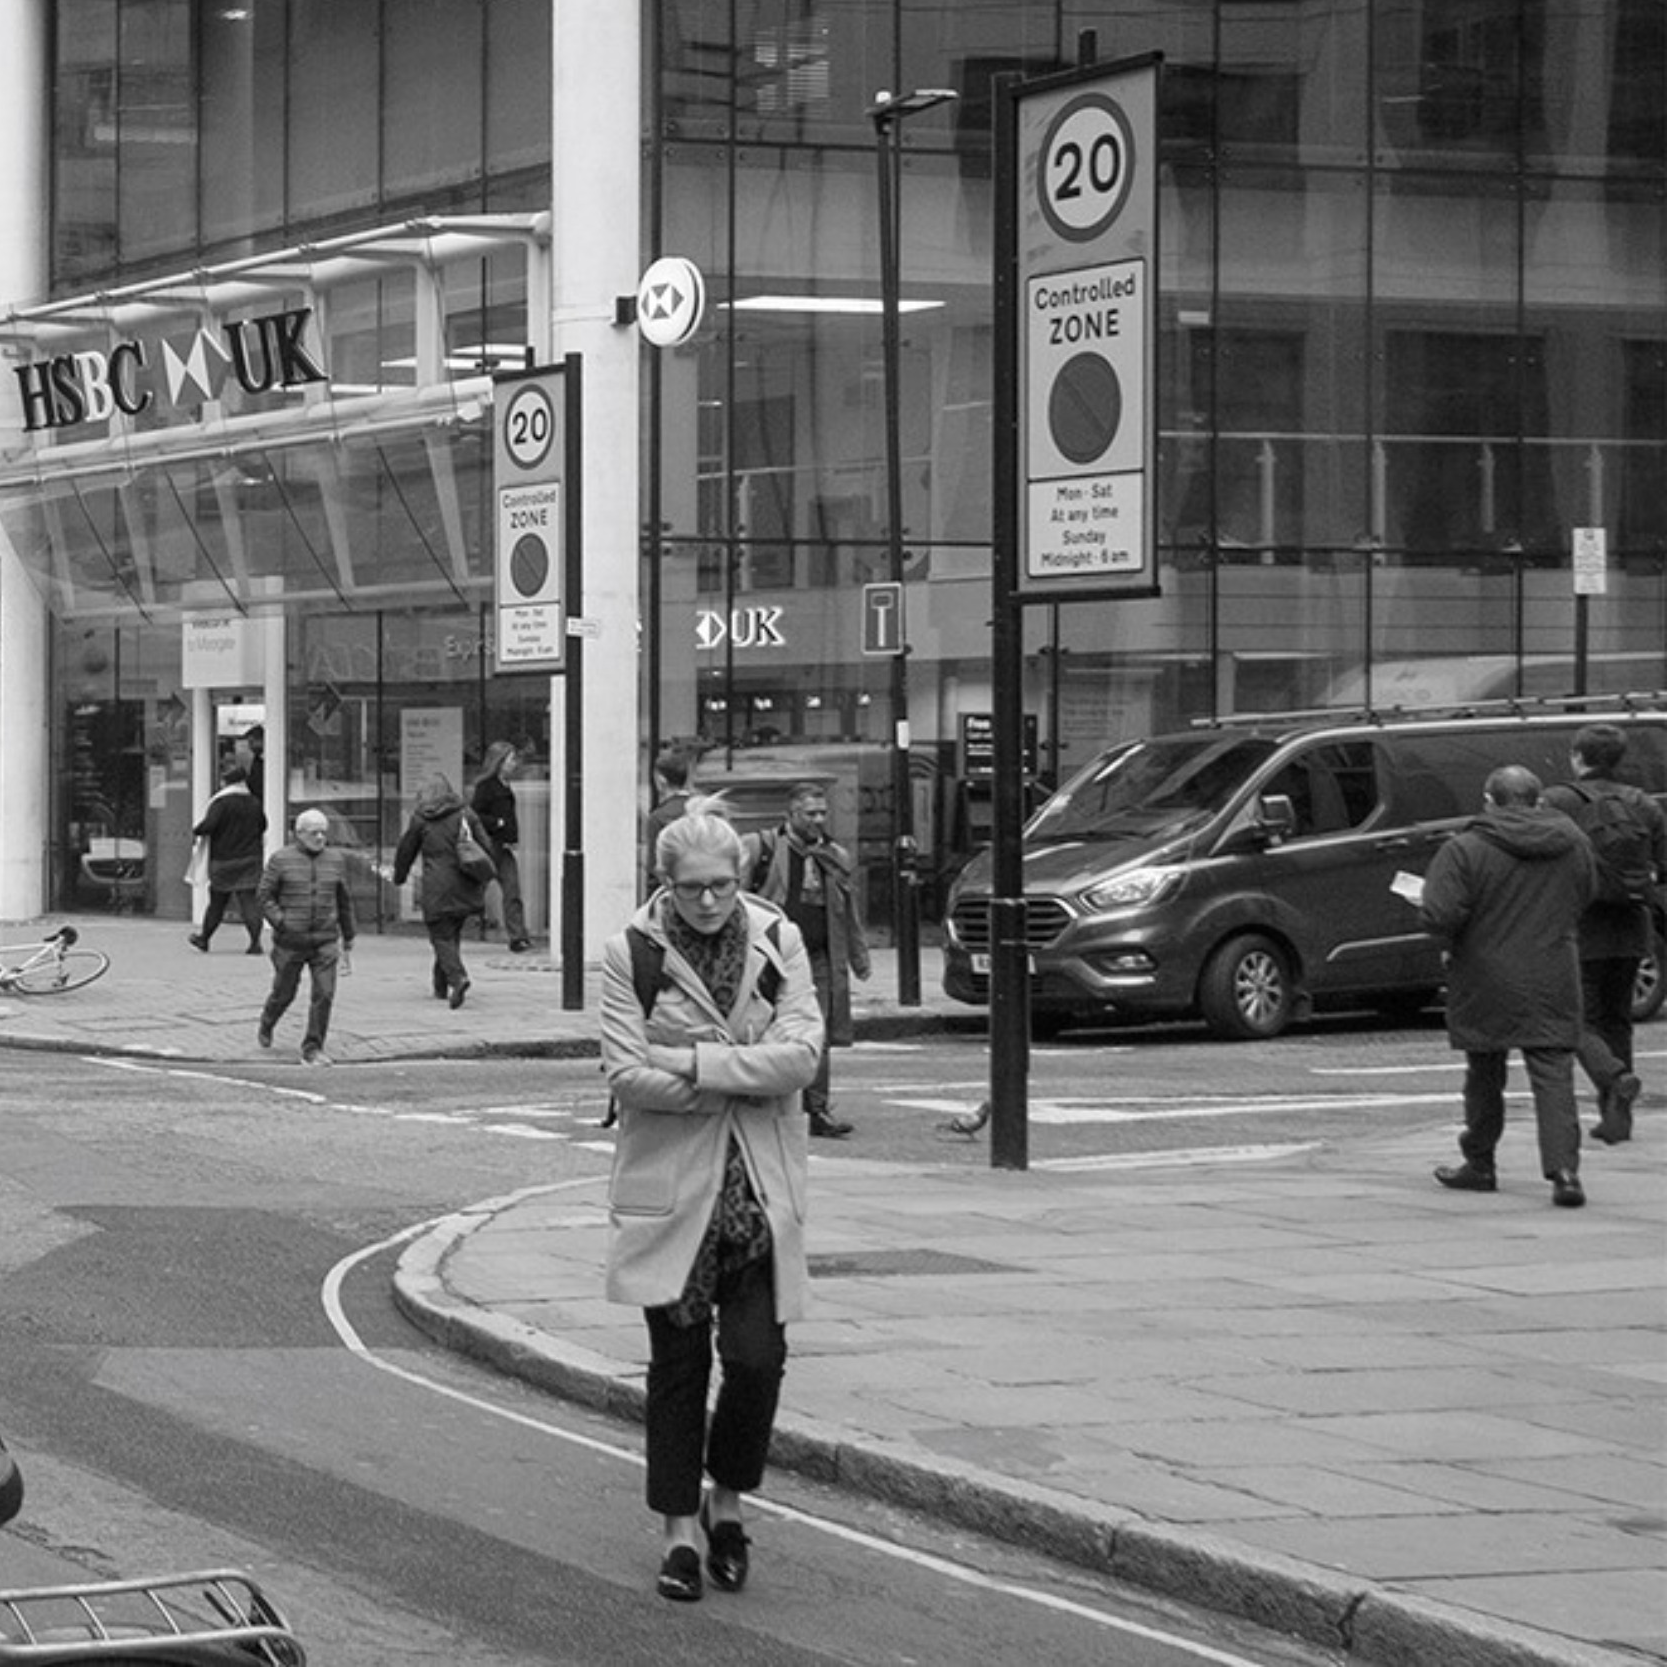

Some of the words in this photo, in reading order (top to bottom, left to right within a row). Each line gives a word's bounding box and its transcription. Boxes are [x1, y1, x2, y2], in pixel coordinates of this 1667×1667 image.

[1054, 133, 1121, 202] 20
[1034, 273, 1136, 310] Controlled
[1049, 308, 1120, 345] ZONE
[12, 339, 153, 433] HSBC
[222, 306, 332, 395] UK
[512, 407, 548, 445] 20
[503, 490, 557, 509] Controlled
[1056, 486, 1083, 502] Mon
[1091, 482, 1113, 499] Sat
[510, 508, 548, 529] ZONE
[1050, 508, 1065, 522] At
[1067, 509, 1088, 523] any
[1091, 505, 1118, 521] time
[1062, 529, 1106, 546] Sunday
[1041, 550, 1092, 568] Midnight
[730, 606, 787, 648] UK
